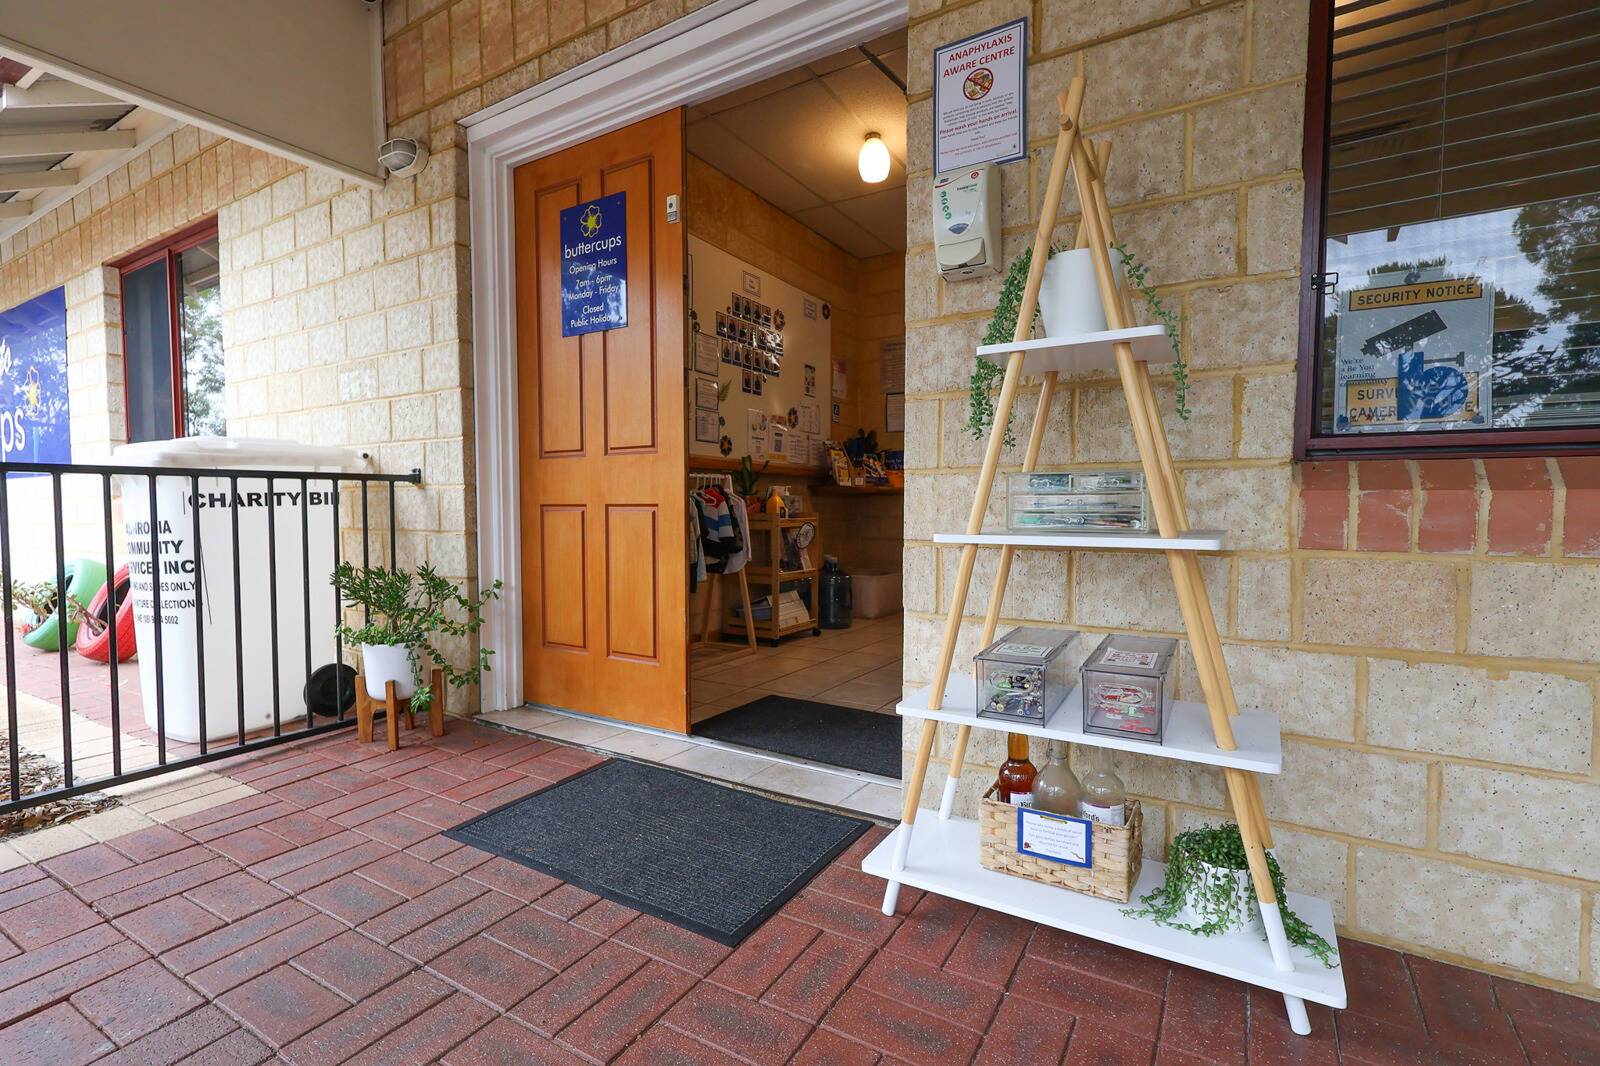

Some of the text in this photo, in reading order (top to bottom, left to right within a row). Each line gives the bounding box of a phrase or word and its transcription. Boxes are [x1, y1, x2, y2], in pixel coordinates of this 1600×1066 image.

[949, 33, 1013, 63] ANAPHYLAXIS
[943, 46, 1016, 78] AWARE CENTRE
[565, 235, 622, 259] buttercups
[569, 257, 618, 275] Opening Hours
[576, 279, 591, 289] 7am
[596, 274, 613, 286] 6pm
[568, 289, 594, 301] Monday
[599, 284, 619, 296] Friday
[1357, 283, 1475, 306] SECURITY NOTICE
[582, 303, 604, 315] Closed
[570, 317, 589, 328] Public
[1357, 387, 1398, 401] SURV
[188, 491, 301, 509] CHARITY
[164, 559, 195, 575] INC
[170, 580, 196, 592] ONLY
